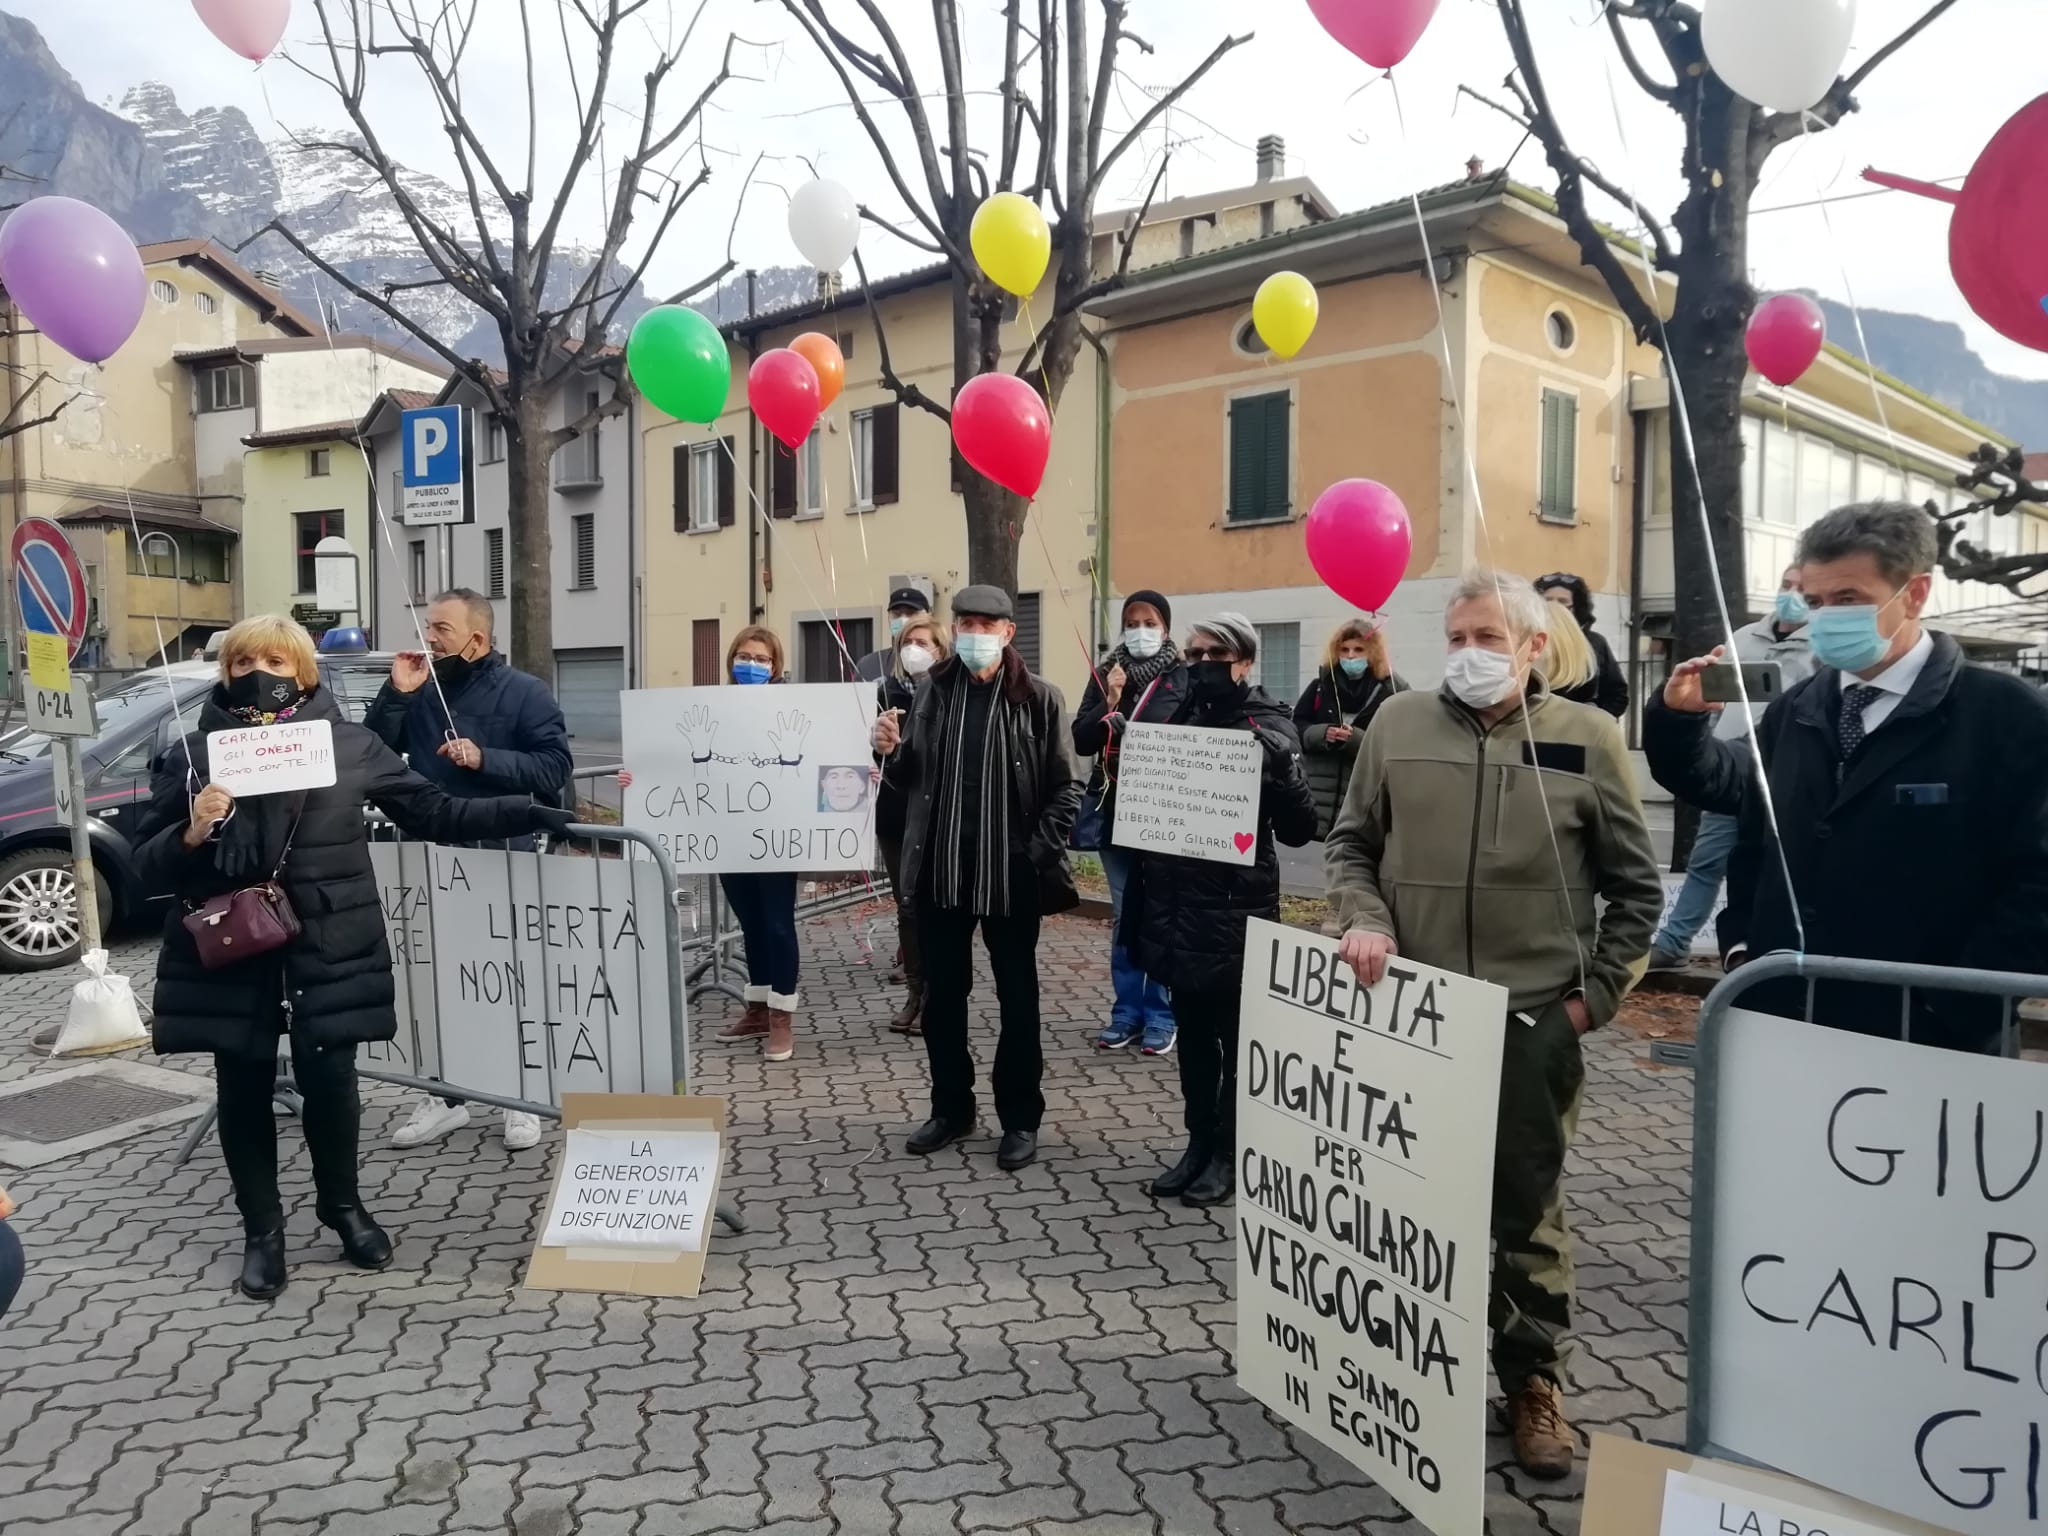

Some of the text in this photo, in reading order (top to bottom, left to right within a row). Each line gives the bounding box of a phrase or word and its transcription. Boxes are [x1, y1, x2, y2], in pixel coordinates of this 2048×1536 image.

[414, 417, 448, 477] P
[415, 487, 449, 497] PUBBLICO
[38, 691, 73, 719] 0-24
[218, 728, 311, 745] CARLO TUTTI
[1206, 736, 1256, 748] CHIEDIAMO
[224, 744, 302, 761] GLI ONESTI
[1123, 753, 1154, 763] COSTOSO
[1170, 756, 1213, 771] PREZIOSO
[1219, 764, 1236, 773] PER
[1240, 766, 1256, 774] UN
[1137, 743, 1165, 752] REGALO
[1168, 746, 1182, 755] PER
[1187, 749, 1222, 759] NATALE
[1227, 753, 1249, 761] NON
[217, 768, 252, 778] SONO
[259, 764, 281, 772] CON
[645, 781, 772, 818] CARLO
[1120, 793, 1149, 804] CARLO
[1152, 797, 1185, 810] LIBERO
[1187, 803, 1202, 813] SIN
[1204, 806, 1217, 816] DA
[1121, 779, 1249, 804] SE GIUSTIZIA ESISTE ANCORA
[1140, 829, 1176, 841] CARLO
[1168, 817, 1185, 826] PER
[749, 827, 859, 861] SUBITO
[436, 853, 471, 892] LA
[489, 899, 645, 950] LIBERTÀ
[460, 960, 620, 1017] NON HA
[519, 1021, 603, 1073] ETÀ
[1333, 1030, 1354, 1075] E
[1249, 1039, 1418, 1159] DIGNITÀ
[630, 1141, 653, 1157] LA
[1315, 1135, 1366, 1187] PER
[574, 1164, 705, 1183] GENEROSITA'
[577, 1188, 688, 1206] NON E' UNA
[560, 1211, 693, 1230] DISFUNZIONE
[1242, 1147, 1456, 1302] CARLO GILARDI
[1241, 1217, 1460, 1397] VERGOGNA
[1266, 1312, 1421, 1433] NON SIAMO
[1285, 1372, 1442, 1493] IN EGITTO
[1719, 1502, 1762, 1536] LA
